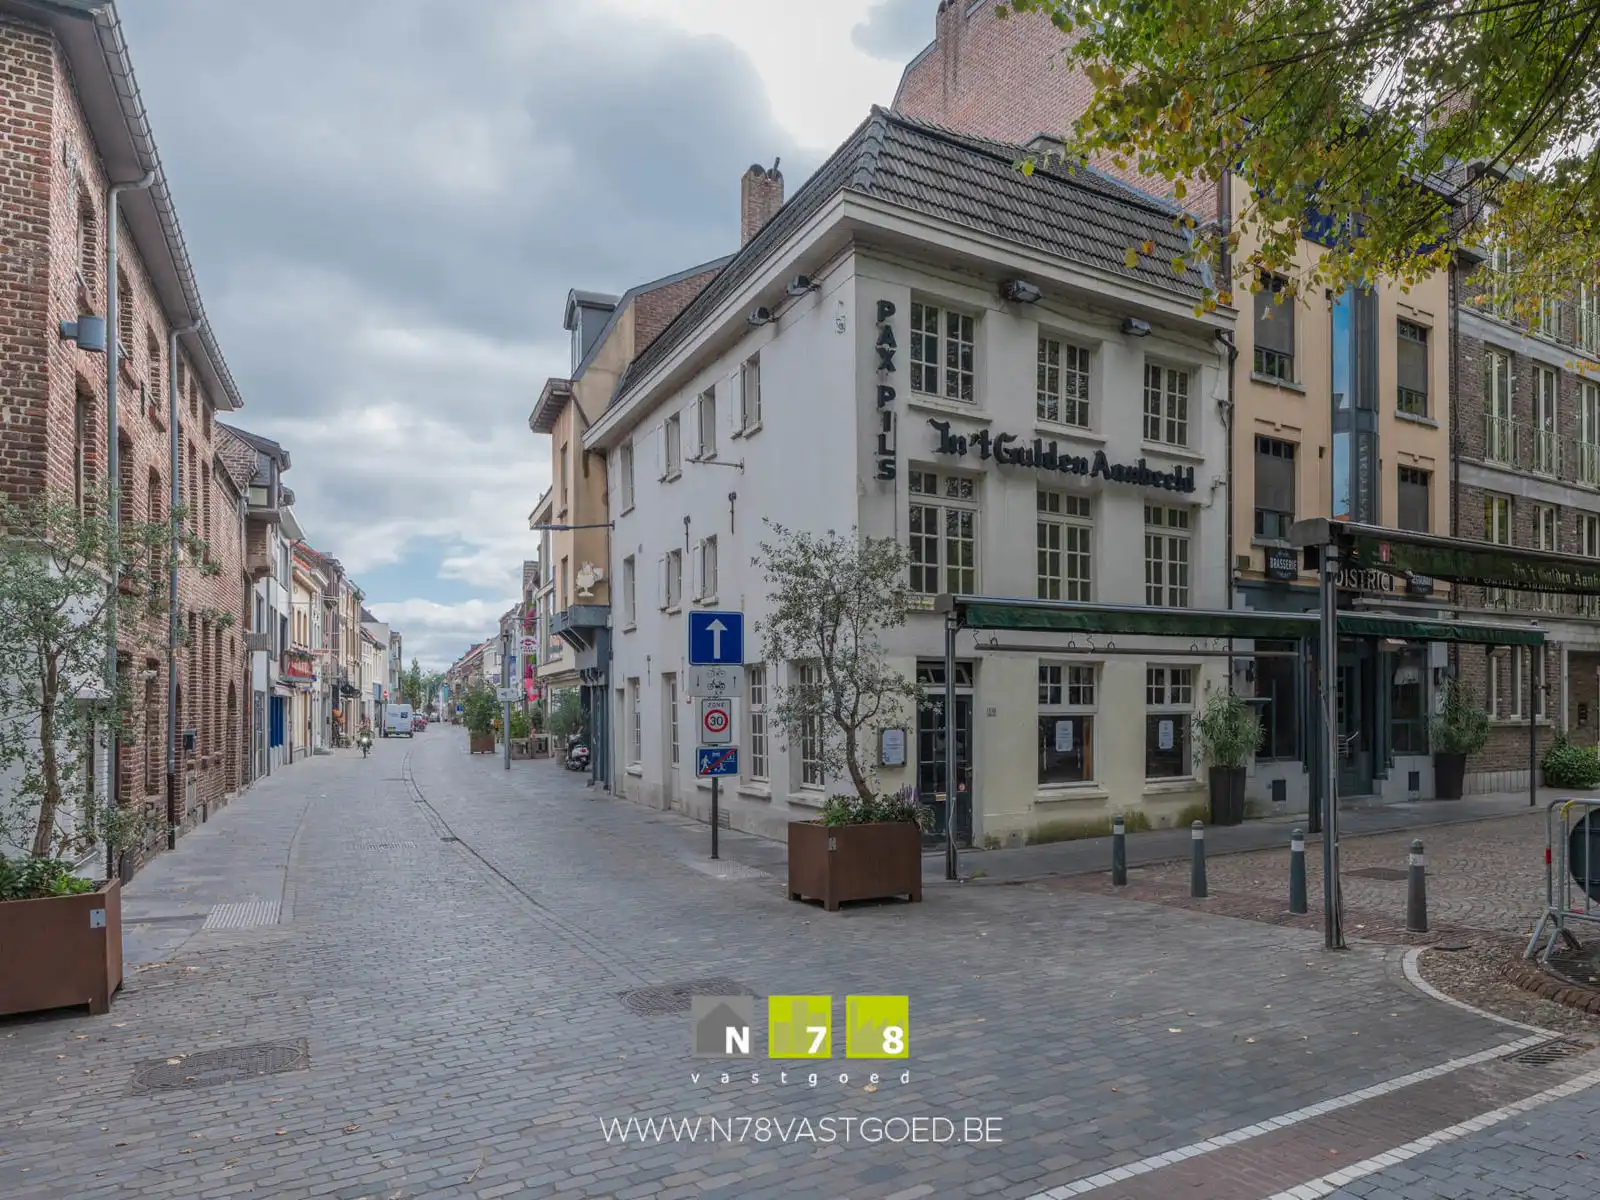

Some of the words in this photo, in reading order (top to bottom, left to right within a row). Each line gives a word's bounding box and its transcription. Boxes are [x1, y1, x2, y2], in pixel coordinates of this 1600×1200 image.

[877, 299, 898, 372] PAX
[877, 384, 897, 480] PILS
[927, 417, 967, 456] In
[993, 432, 1089, 475] Gulden
[709, 716, 724, 726] 30
